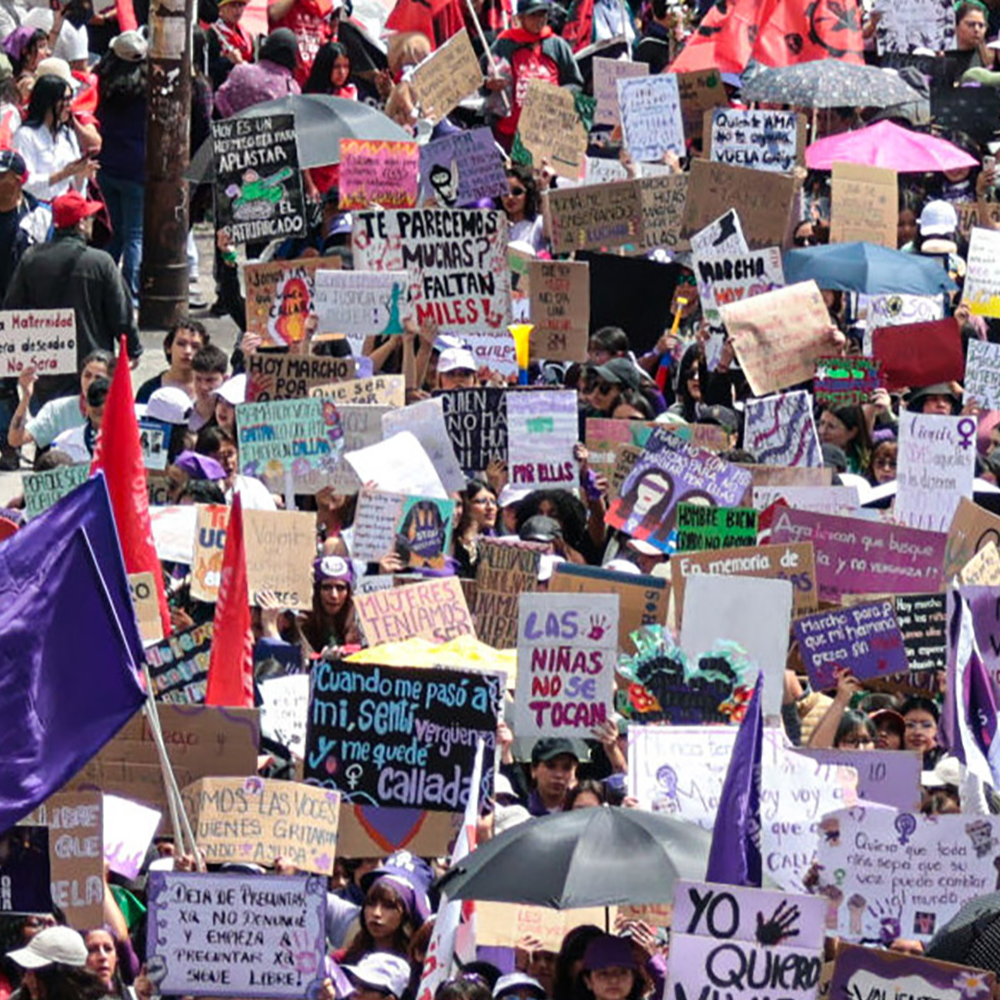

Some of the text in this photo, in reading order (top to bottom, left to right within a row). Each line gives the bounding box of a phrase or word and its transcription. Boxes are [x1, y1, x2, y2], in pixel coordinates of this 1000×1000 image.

[358, 211, 497, 239] TE PARECEMOS
[424, 273, 495, 299] FALTAN
[249, 359, 348, 379] HOY MARCHO
[276, 379, 306, 394] POR
[781, 550, 798, 568] de
[524, 611, 578, 640] LAS
[531, 646, 602, 674] NIÑAS
[318, 665, 487, 713] Cuando me pasó a
[532, 676, 596, 698] NO SE
[358, 698, 414, 735] sentí
[415, 719, 496, 756] vergüenza
[529, 702, 606, 727] TOCAN
[310, 736, 428, 768] y me quedé
[686, 888, 740, 940] YO
[706, 943, 820, 989] QUIERO
